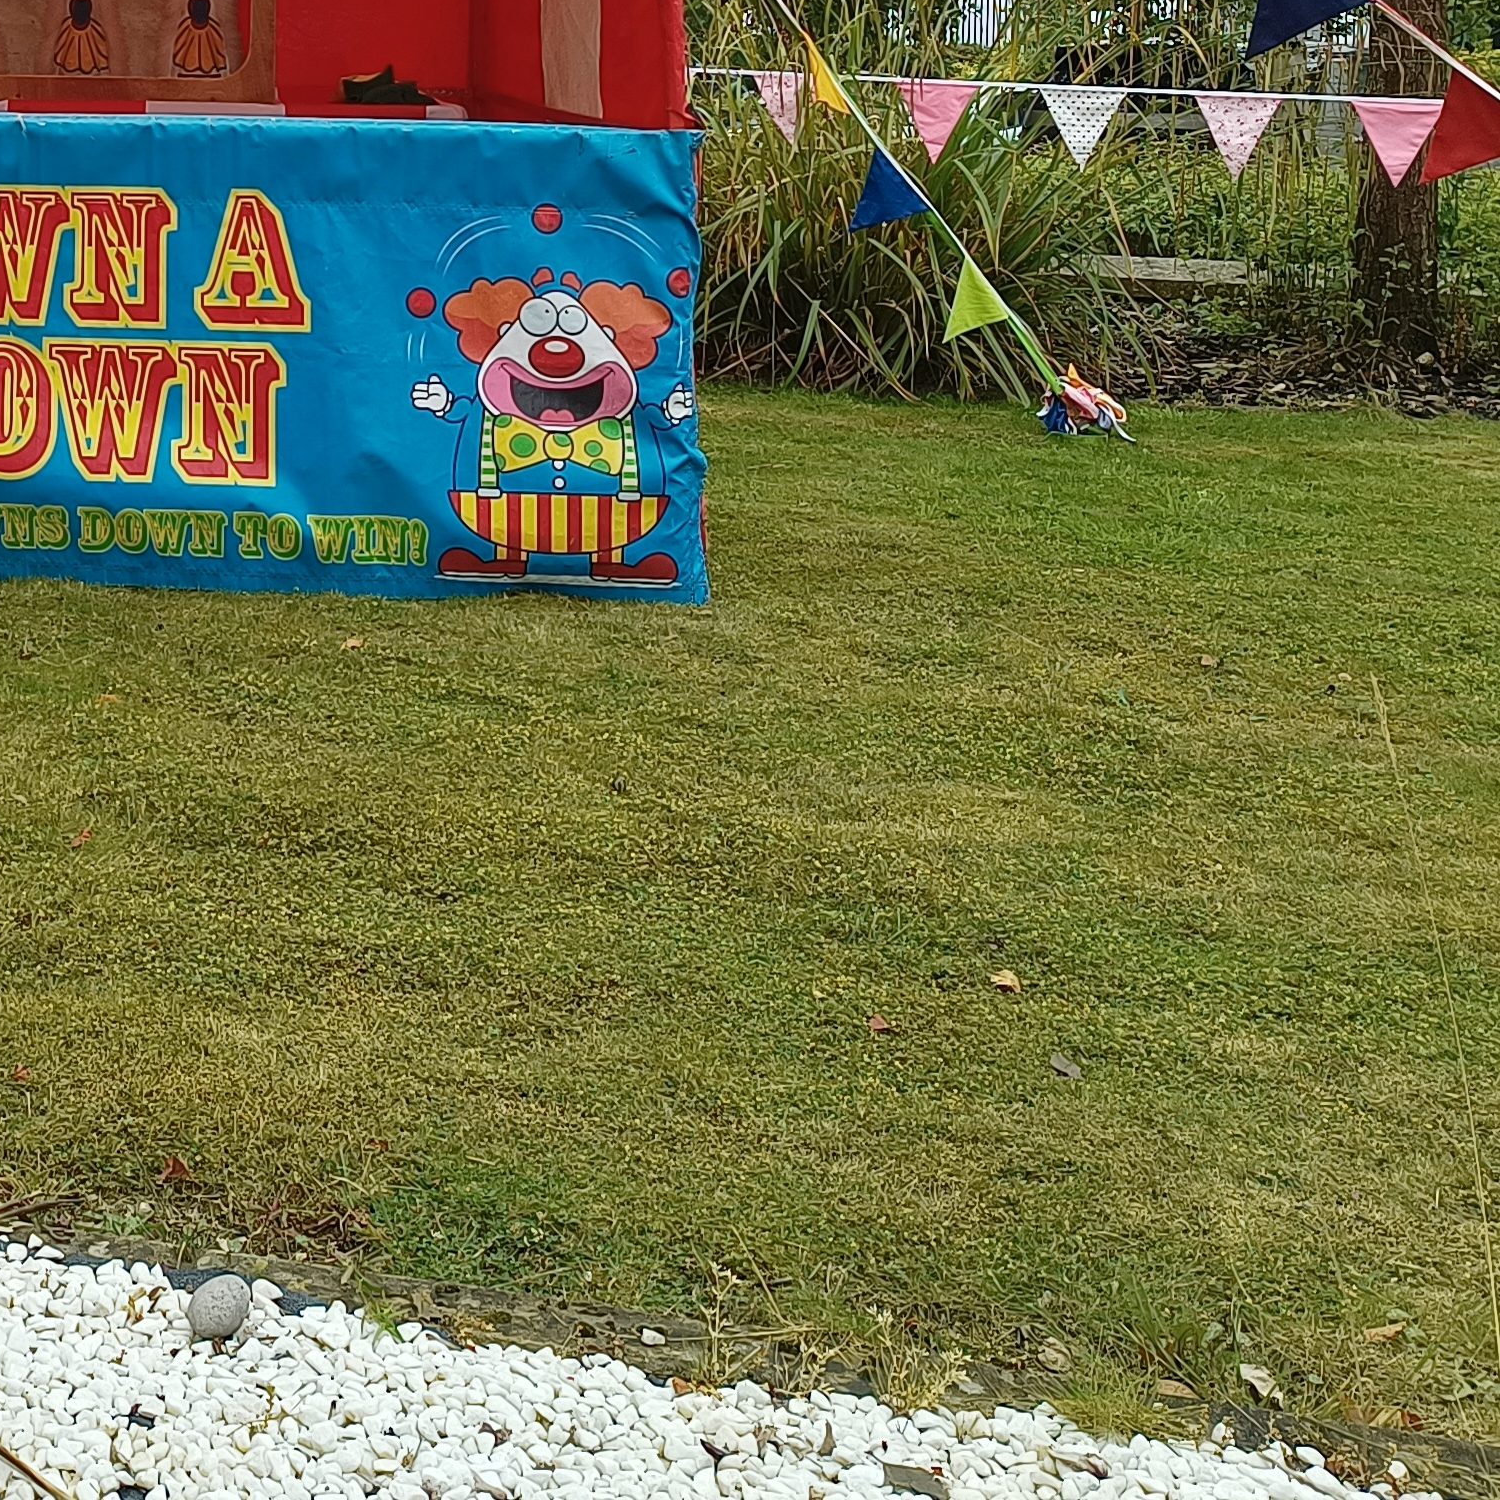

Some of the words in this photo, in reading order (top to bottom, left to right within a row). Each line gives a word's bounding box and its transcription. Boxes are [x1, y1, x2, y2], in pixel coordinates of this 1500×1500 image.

[193, 188, 312, 333] A
[77, 506, 228, 558] DOWN
[233, 511, 302, 559] TO
[307, 514, 430, 566] WIN!
